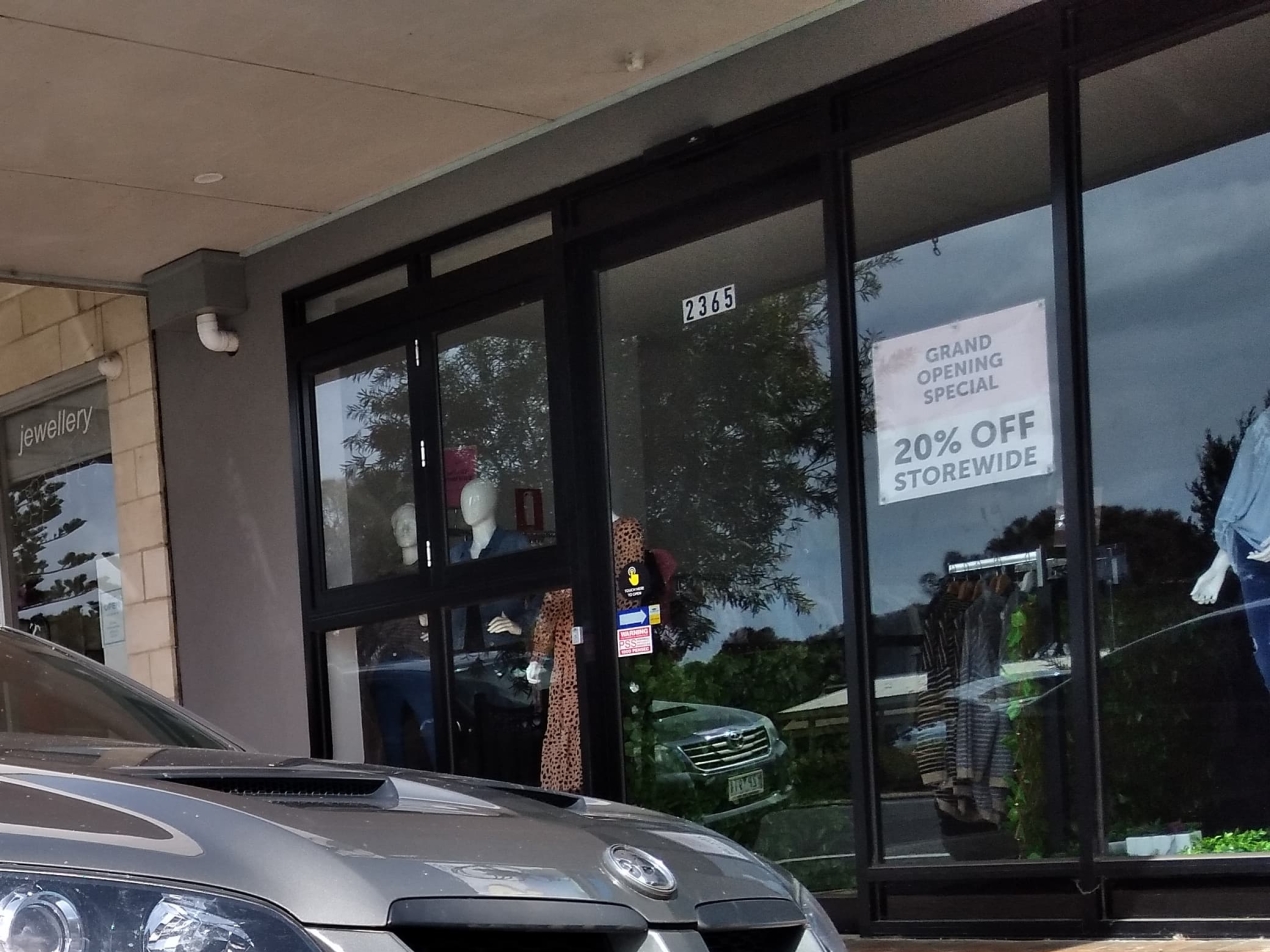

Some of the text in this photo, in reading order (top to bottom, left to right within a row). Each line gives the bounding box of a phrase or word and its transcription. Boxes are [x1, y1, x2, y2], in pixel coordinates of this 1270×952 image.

[686, 287, 733, 321] 2365
[925, 334, 993, 364] GRAND
[916, 352, 1004, 386] OPENING
[922, 374, 999, 405] SPECIAL
[18, 405, 93, 456] jewellery
[893, 409, 1036, 466] 20% OFF
[893, 445, 1037, 492] STOREWIDE
